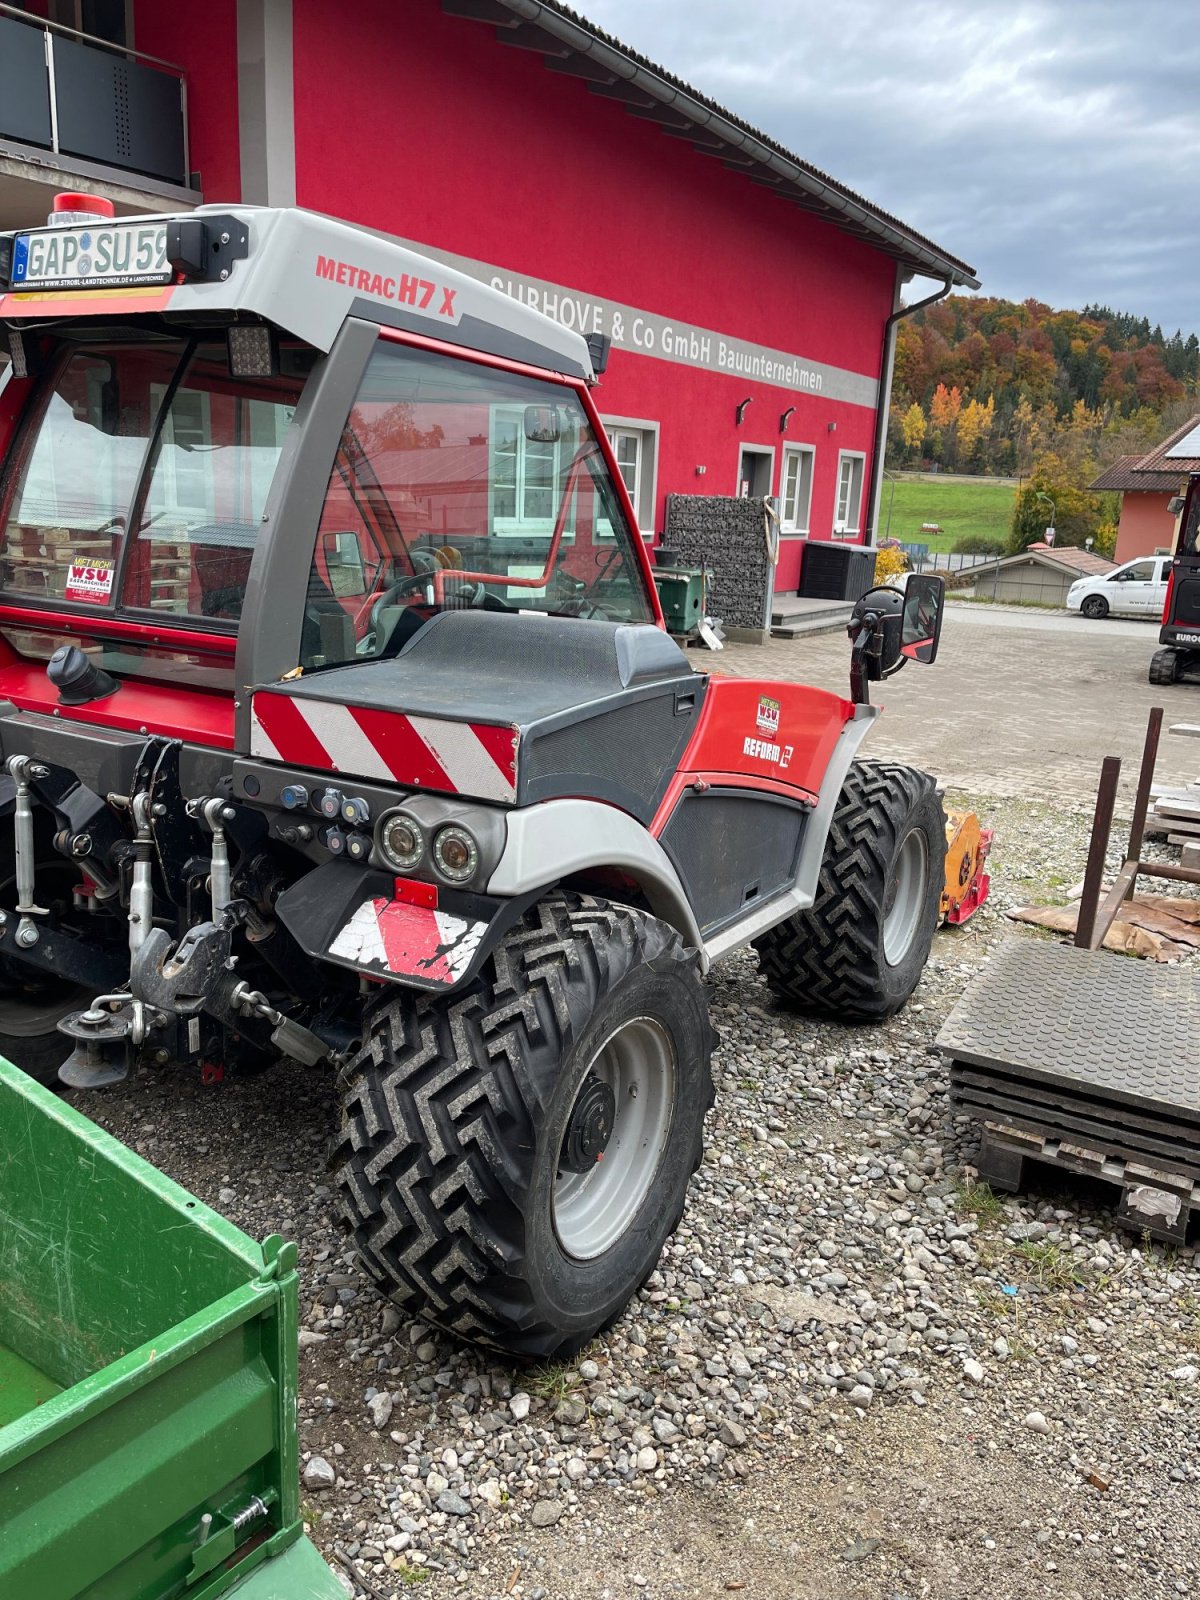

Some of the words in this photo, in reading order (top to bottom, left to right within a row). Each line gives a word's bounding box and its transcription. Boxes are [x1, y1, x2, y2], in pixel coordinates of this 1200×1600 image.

[17, 264, 24, 275] D
[29, 237, 78, 277] GAP
[94, 232, 131, 273] SU
[44, 277, 129, 288] WWW.STROBL-LANDTECHNIK.DE
[133, 275, 165, 283] LANDTECHNIK
[315, 255, 396, 300] METRAC
[397, 273, 437, 310] H7
[438, 287, 457, 318] X
[611, 311, 625, 342] &
[632, 317, 655, 349] Co
[661, 327, 711, 364] GmbH
[718, 342, 823, 391] Bauunternehmen
[743, 736, 781, 763] REFORM
